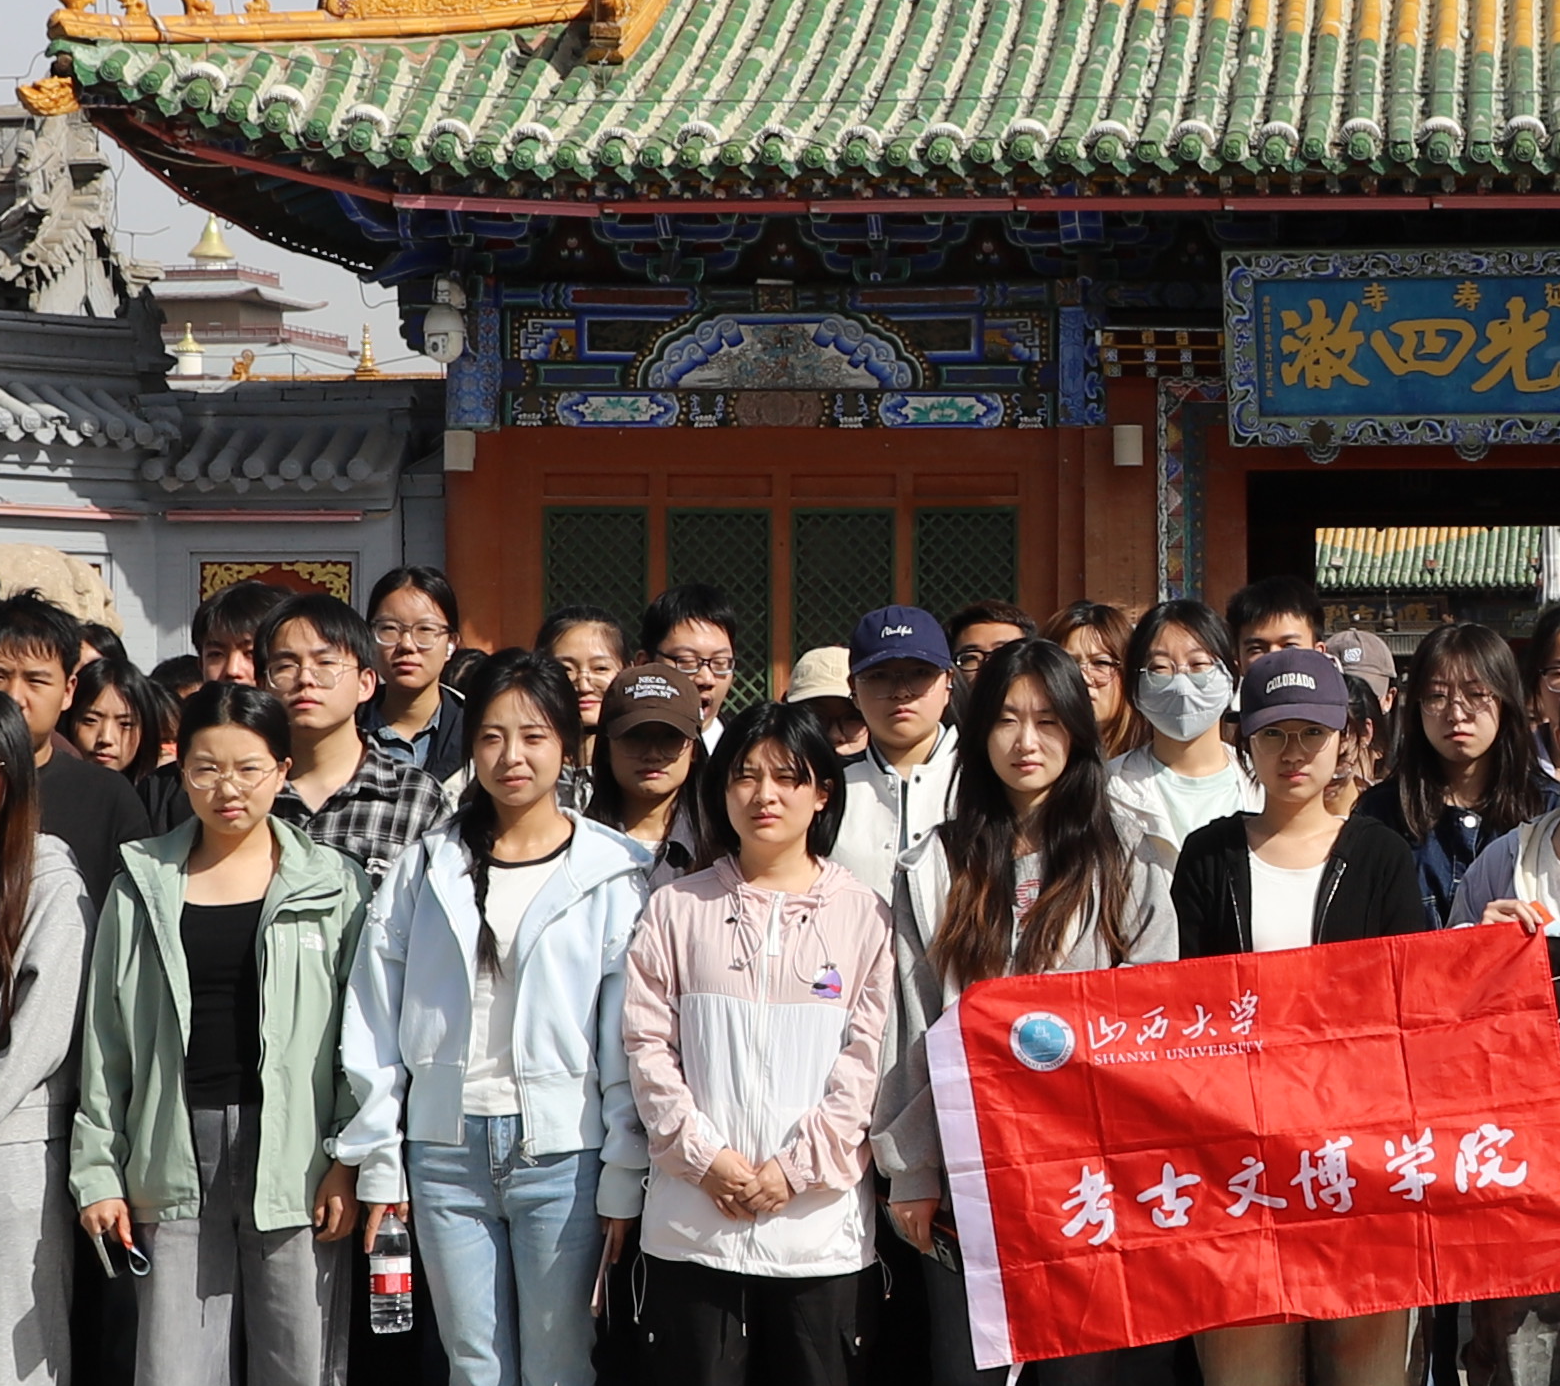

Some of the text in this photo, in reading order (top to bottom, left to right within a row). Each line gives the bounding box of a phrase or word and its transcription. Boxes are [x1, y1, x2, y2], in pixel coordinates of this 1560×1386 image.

[1266, 672, 1316, 694] COLORADO
[1087, 989, 1260, 1050] 山西大学
[1093, 1039, 1264, 1067] SHANXI UNIVERSITY
[1060, 1122, 1528, 1247] 考古文博学院
